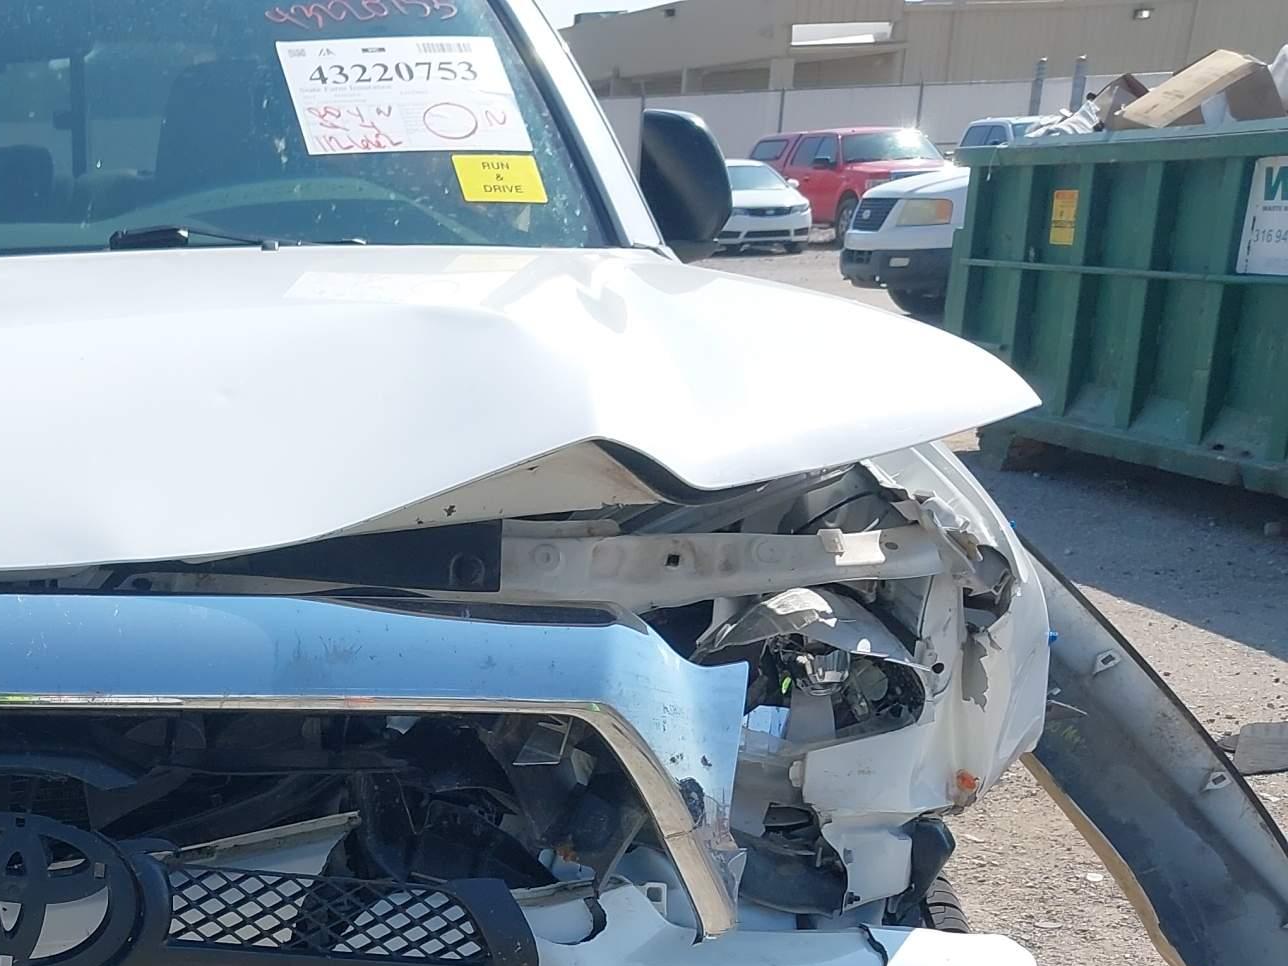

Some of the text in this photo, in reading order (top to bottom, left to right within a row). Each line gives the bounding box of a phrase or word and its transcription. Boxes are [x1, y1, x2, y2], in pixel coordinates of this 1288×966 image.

[309, 61, 478, 84] 43220753
[481, 161, 510, 170] RUN
[495, 173, 504, 181] &
[483, 184, 524, 193] DRIVE
[1253, 229, 1273, 243] 316
